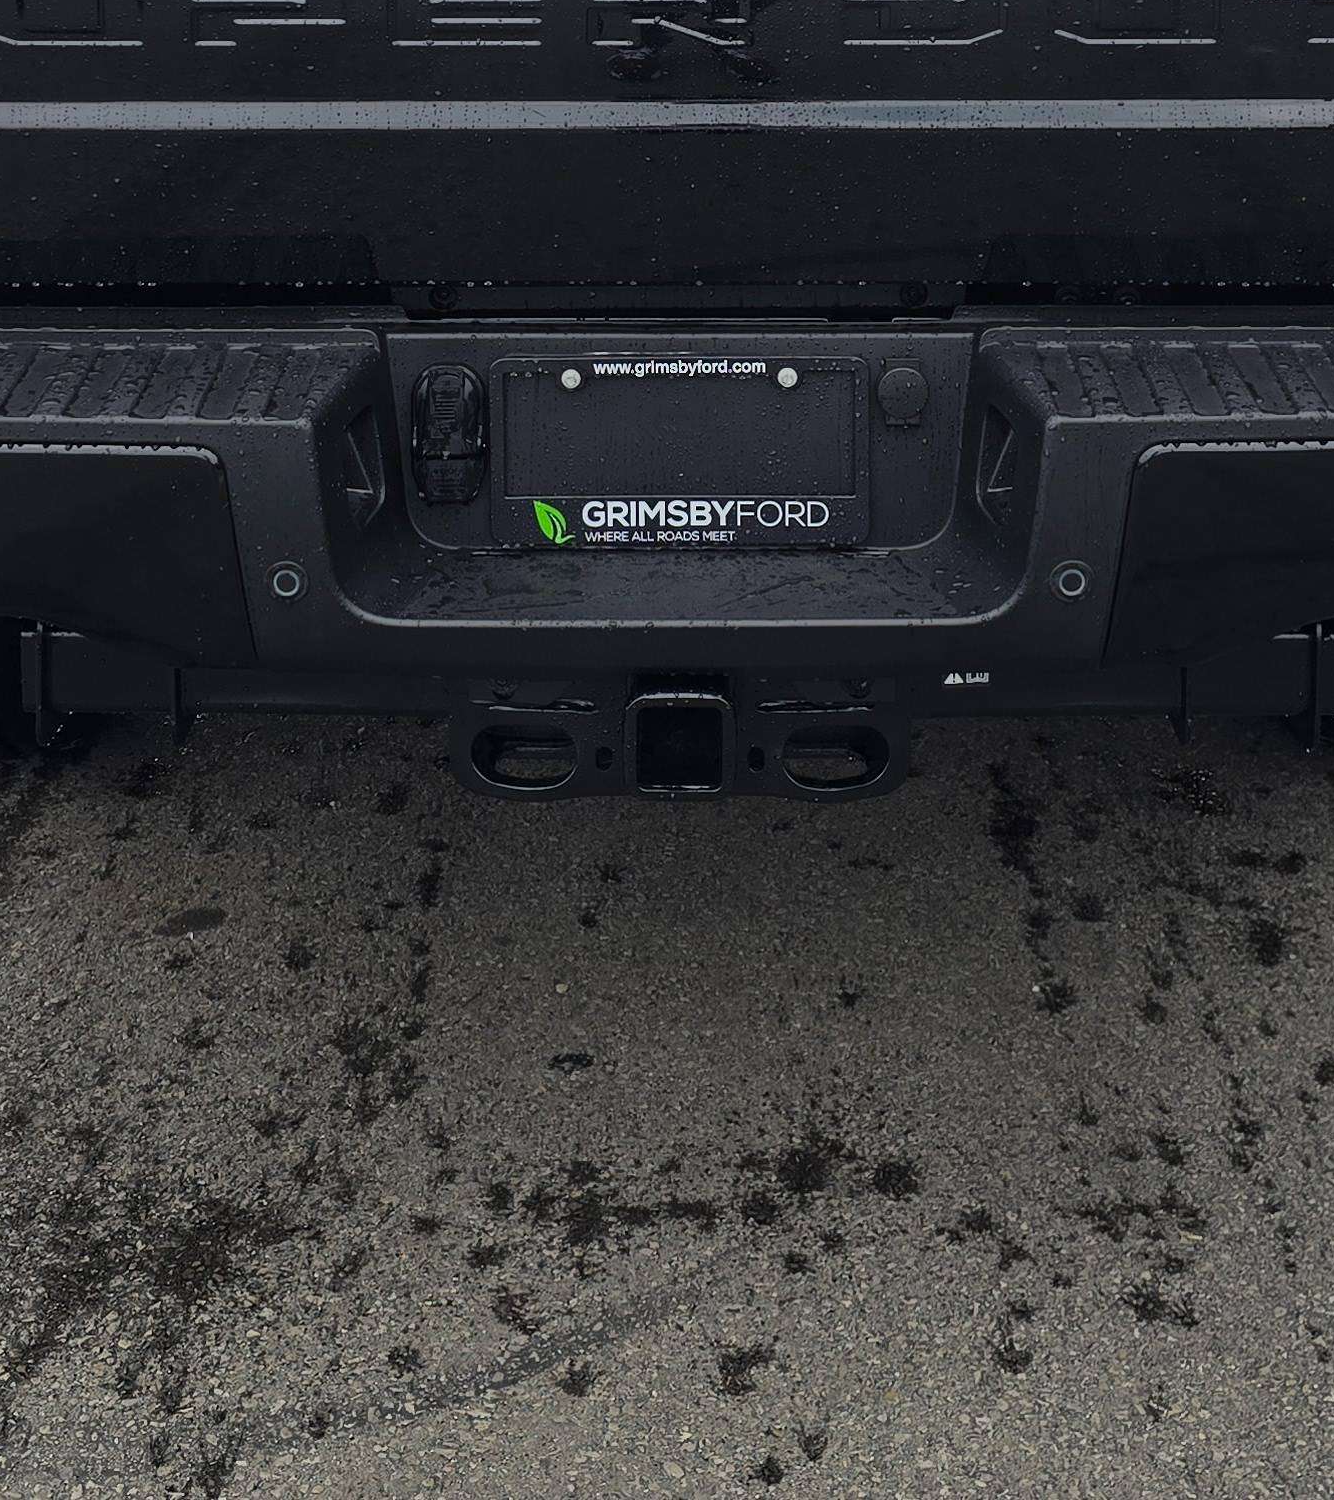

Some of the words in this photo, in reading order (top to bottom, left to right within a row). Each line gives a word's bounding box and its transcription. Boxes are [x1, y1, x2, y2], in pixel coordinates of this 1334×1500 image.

[592, 359, 766, 377] www.grimsbyford.com
[581, 500, 830, 528] GRIMSBYFORD
[584, 531, 629, 543] WHERE
[631, 531, 654, 542] ALL
[657, 531, 700, 542] ROADS
[702, 531, 735, 542] MEET
